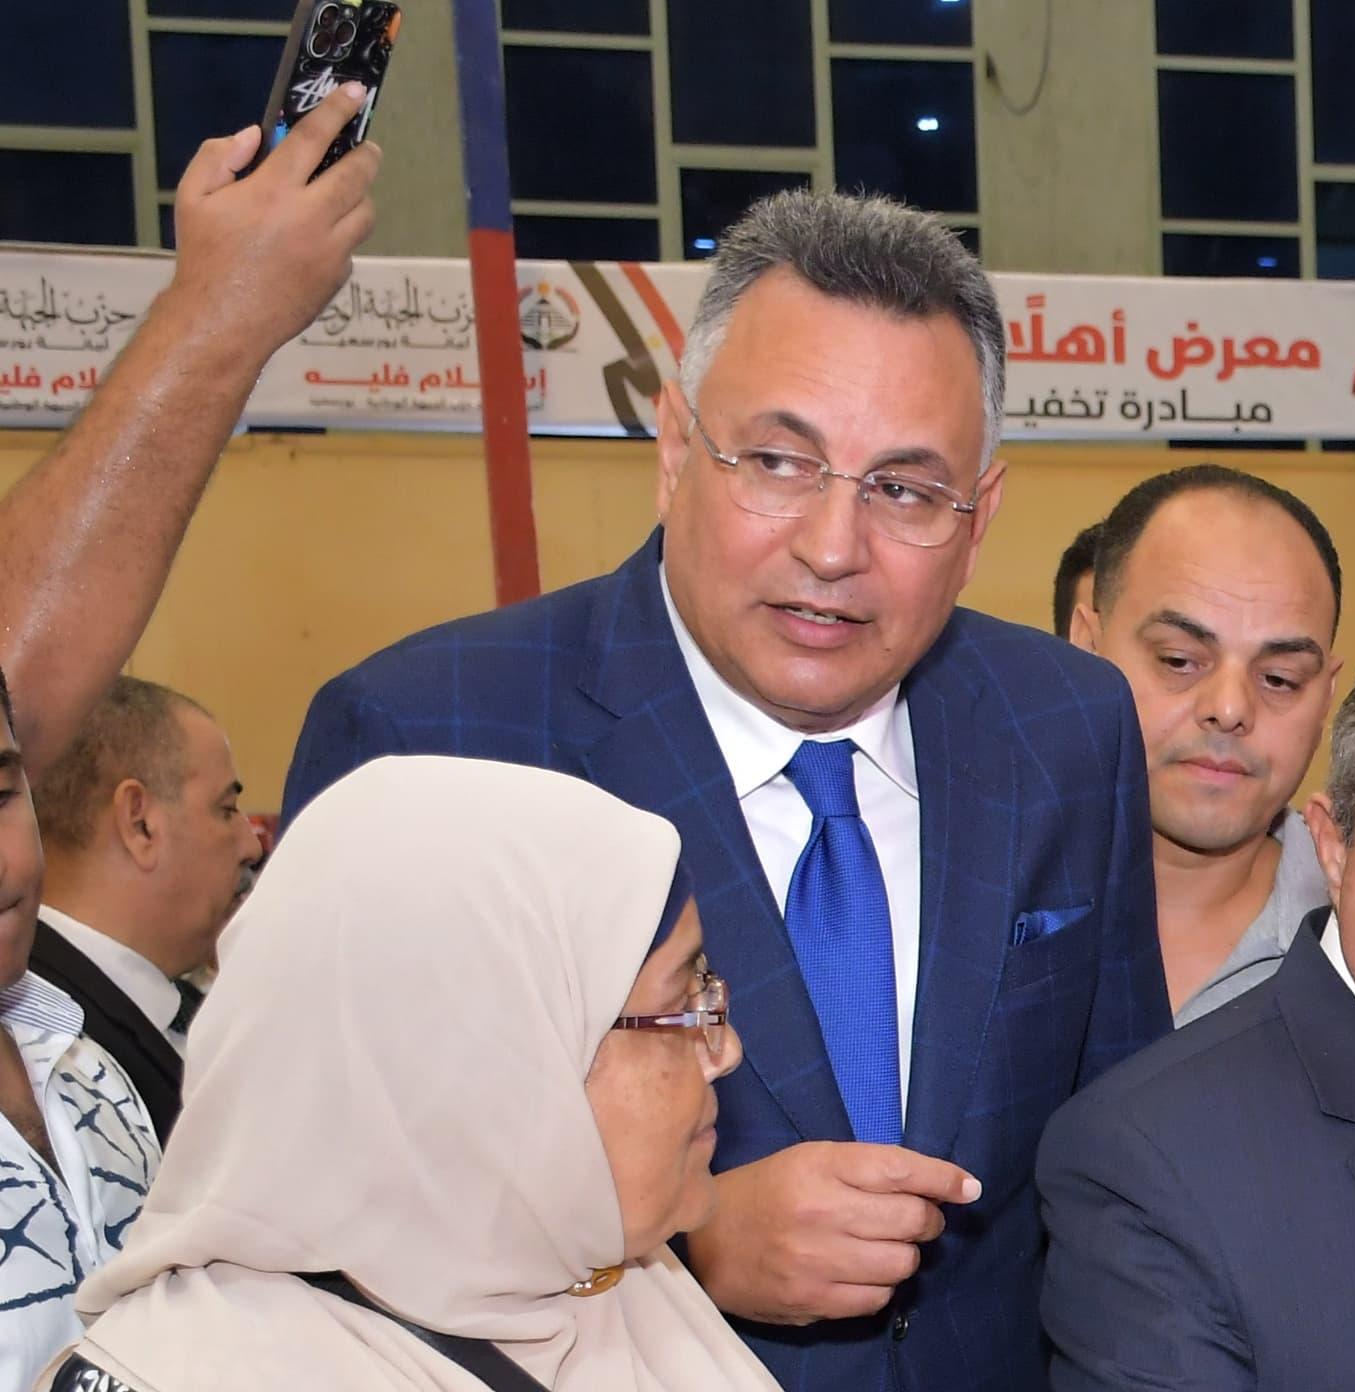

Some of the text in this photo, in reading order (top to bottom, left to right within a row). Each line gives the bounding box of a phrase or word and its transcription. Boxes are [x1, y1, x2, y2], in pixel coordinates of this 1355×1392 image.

[428, 292, 475, 333] زب
[1147, 321, 1322, 380] معرض
[0, 365, 41, 394] فلي
[305, 363, 410, 393] فليه
[1005, 388, 1273, 432] مبادرة تخفي
